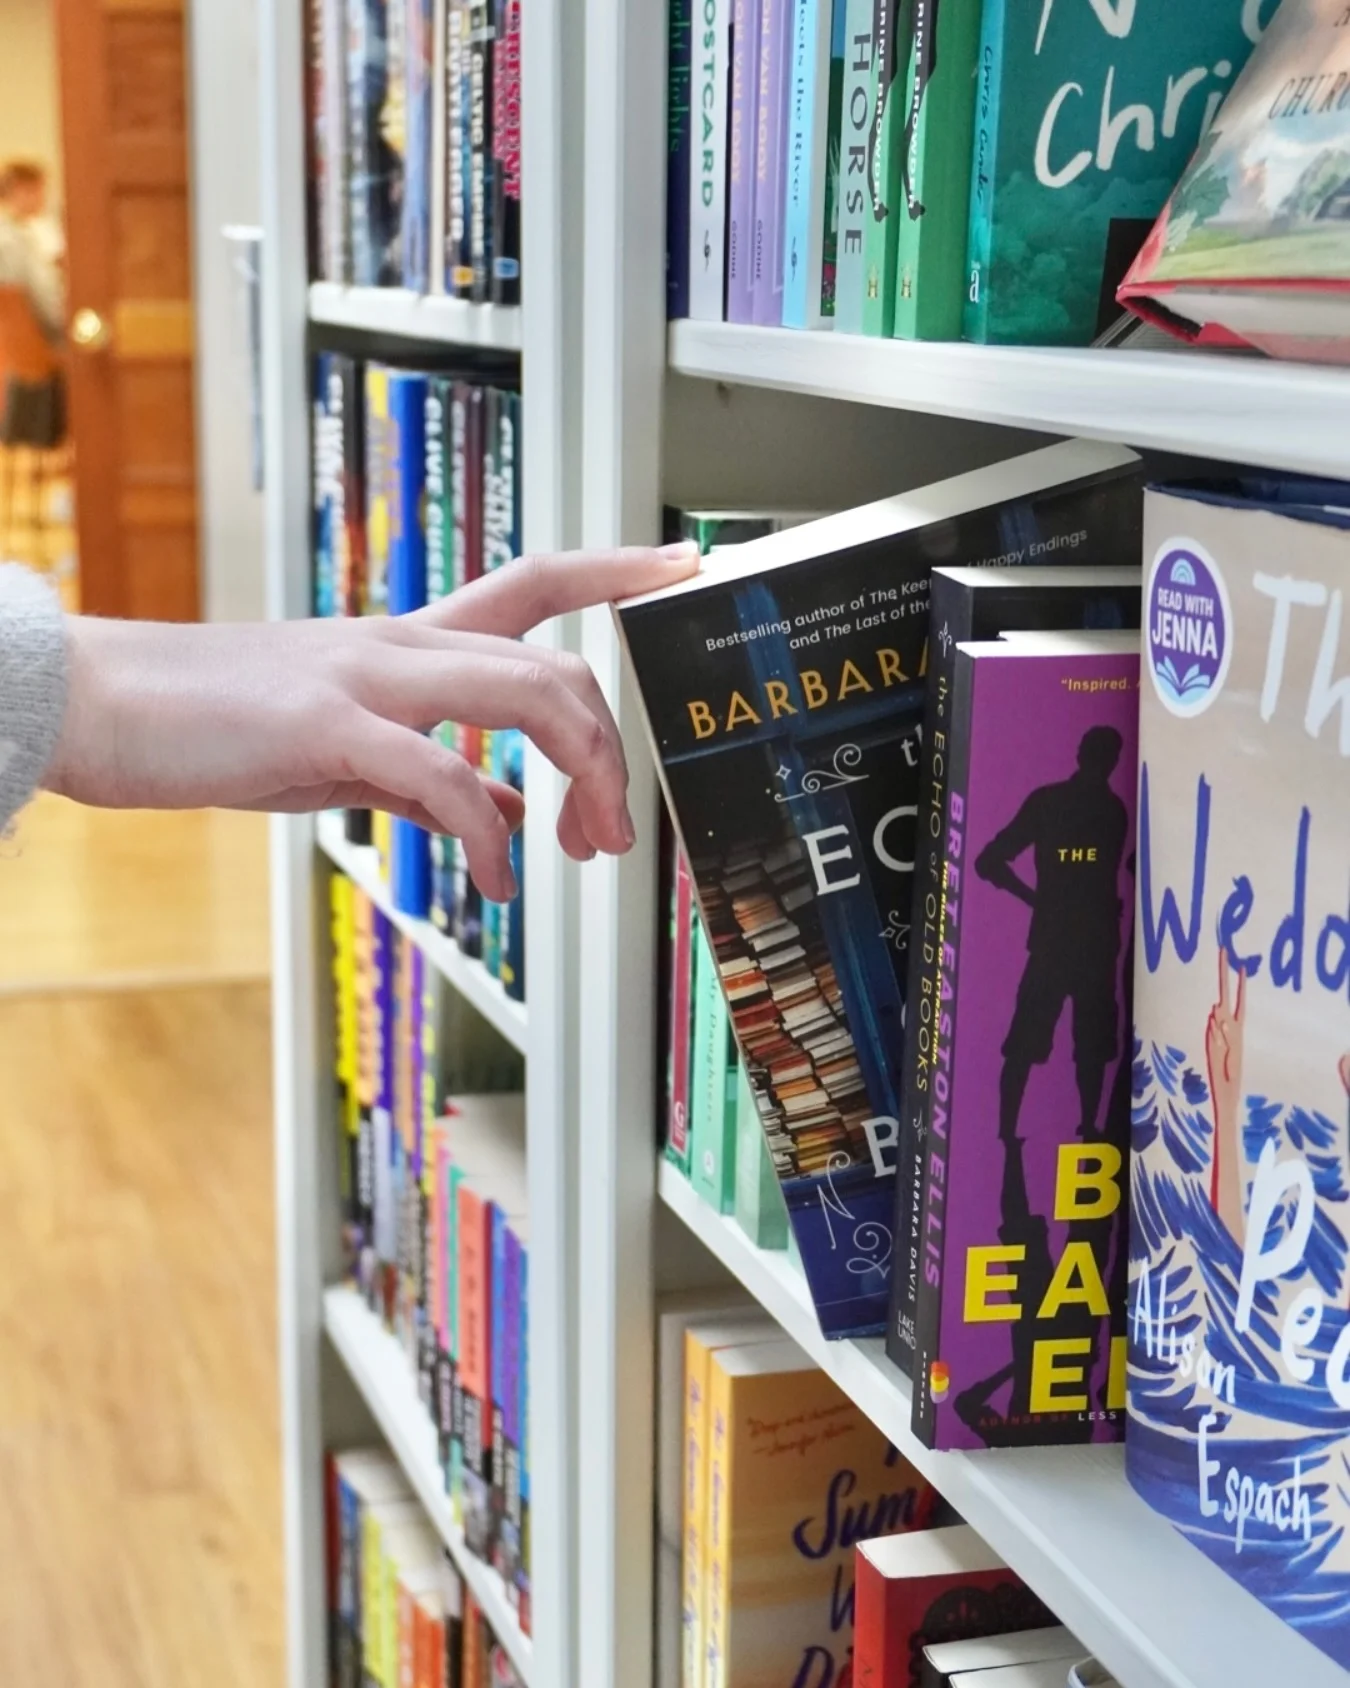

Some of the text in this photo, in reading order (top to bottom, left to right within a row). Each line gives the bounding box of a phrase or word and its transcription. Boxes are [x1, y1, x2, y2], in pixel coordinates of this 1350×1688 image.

[844, 33, 871, 255] HORSE
[872, 83, 884, 212] BROWDER
[907, 76, 920, 209] BROWDER
[705, 619, 791, 652] Bestselling
[795, 602, 846, 628] author
[850, 595, 866, 611] of
[869, 587, 898, 605] The
[1029, 530, 1088, 557] Endings
[789, 630, 821, 650] and
[824, 621, 852, 640] The
[856, 611, 887, 631] Last
[889, 604, 906, 621] of
[1151, 610, 1218, 660] JENNA
[1157, 586, 1214, 618] READ WITH
[938, 676, 948, 717] the
[930, 731, 945, 838] ECHO
[1058, 848, 1097, 862] THE
[923, 892, 937, 964] OLD
[916, 977, 934, 1091] BOOKS
[924, 791, 964, 1289] BRET EASTON ELLIS
[907, 1154, 922, 1303] BARBARA DAVIS
[1134, 1256, 1236, 1405] Alison
[1078, 1410, 1117, 1422] LESS
[1198, 1410, 1312, 1554] Espach
